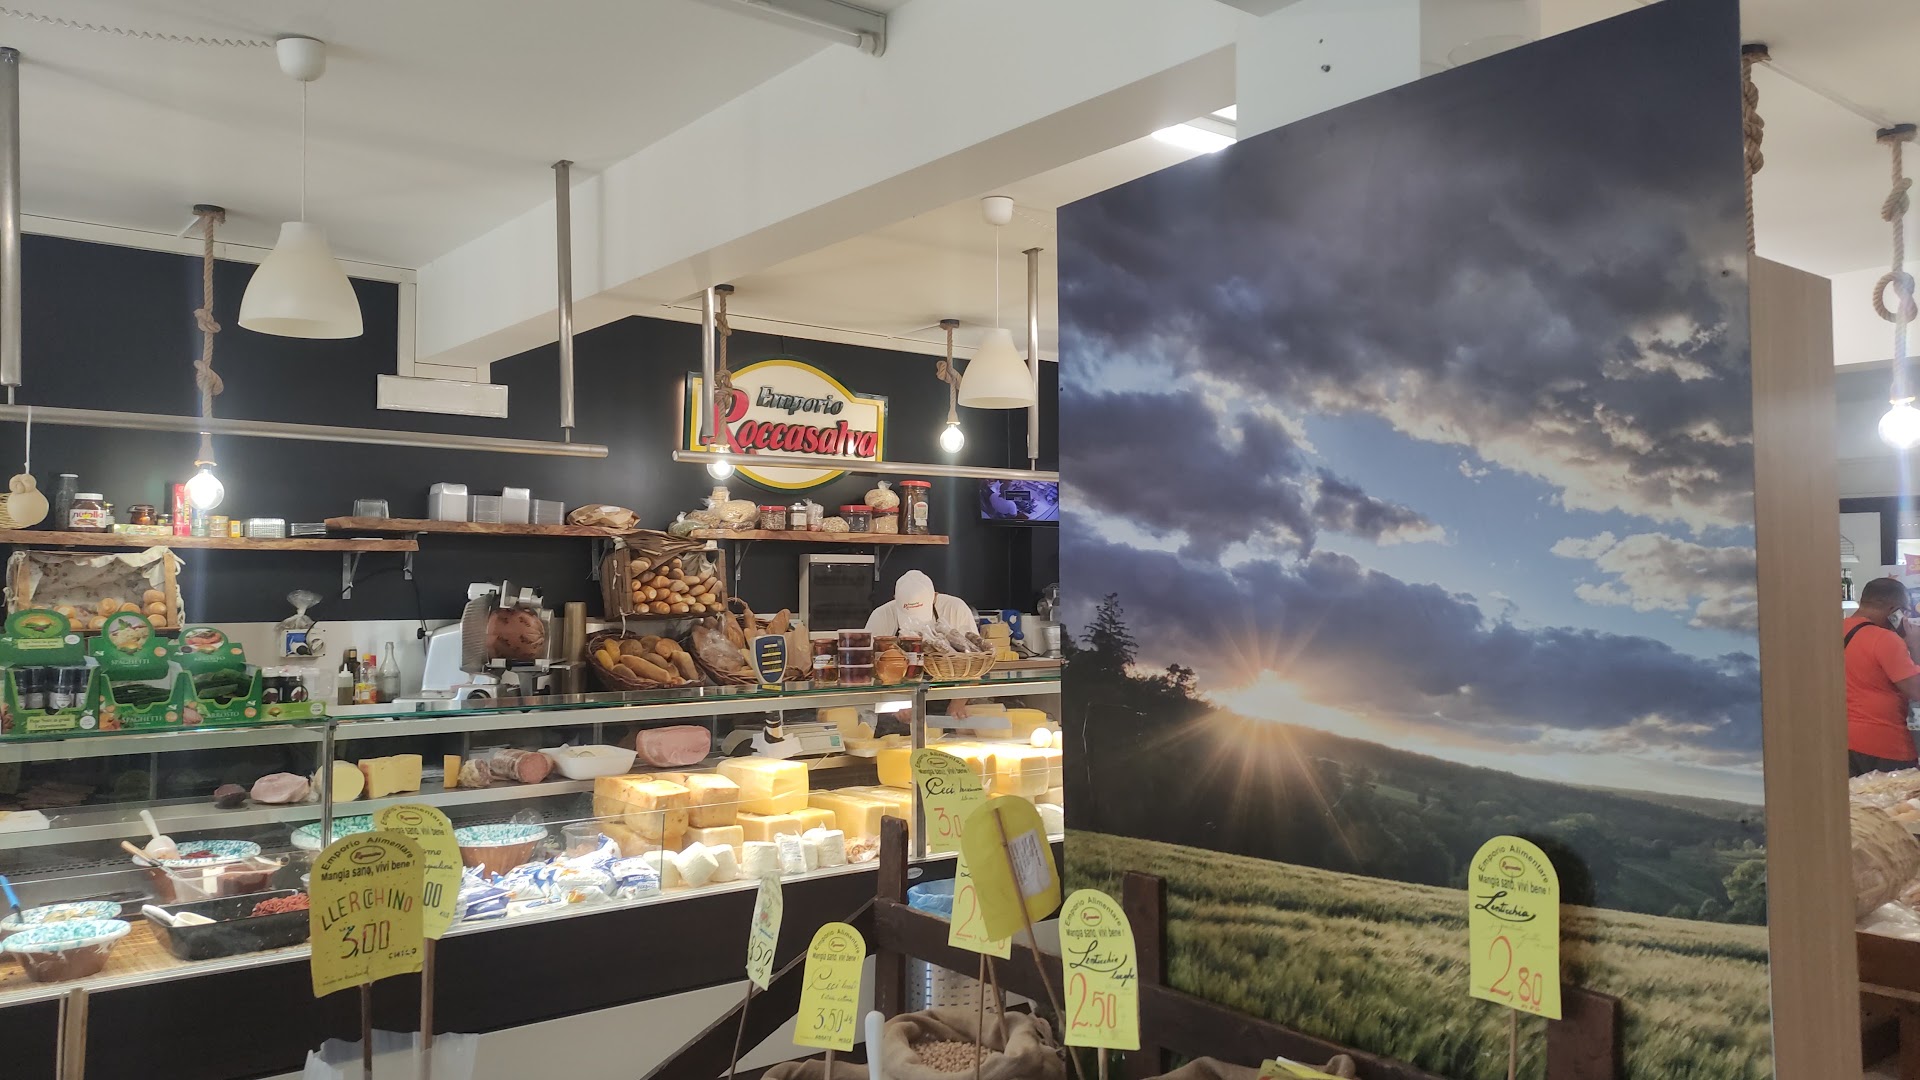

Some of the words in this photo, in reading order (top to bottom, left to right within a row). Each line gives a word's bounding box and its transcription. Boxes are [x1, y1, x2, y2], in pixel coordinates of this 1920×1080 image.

[756, 385, 844, 415] Emporio
[700, 388, 877, 458] Roccasalva
[930, 751, 966, 767] Alimentare
[925, 777, 955, 799] Ceci
[399, 805, 444, 827] Alimentare
[321, 839, 360, 871] Emporio
[367, 837, 414, 859] Alimentare
[1478, 846, 1505, 872] Emporio
[1509, 845, 1549, 883] Alimentare
[321, 868, 350, 882] Mangia
[352, 866, 374, 876] sano,
[376, 860, 390, 872] vivi
[391, 860, 410, 869] bene
[1478, 875, 1500, 888] Mangia
[1517, 880, 1528, 891] vivi
[1530, 881, 1547, 894] bene
[1065, 899, 1085, 926] Emporio
[1088, 896, 1122, 926] Alimentare
[340, 920, 391, 959] 3,00
[814, 930, 835, 951] Emporio
[837, 928, 861, 954] Alimentare
[1066, 929, 1083, 939] Mangia
[1109, 927, 1121, 937] bene
[807, 964, 839, 991] Ceci
[1489, 936, 1542, 1006] 2,80
